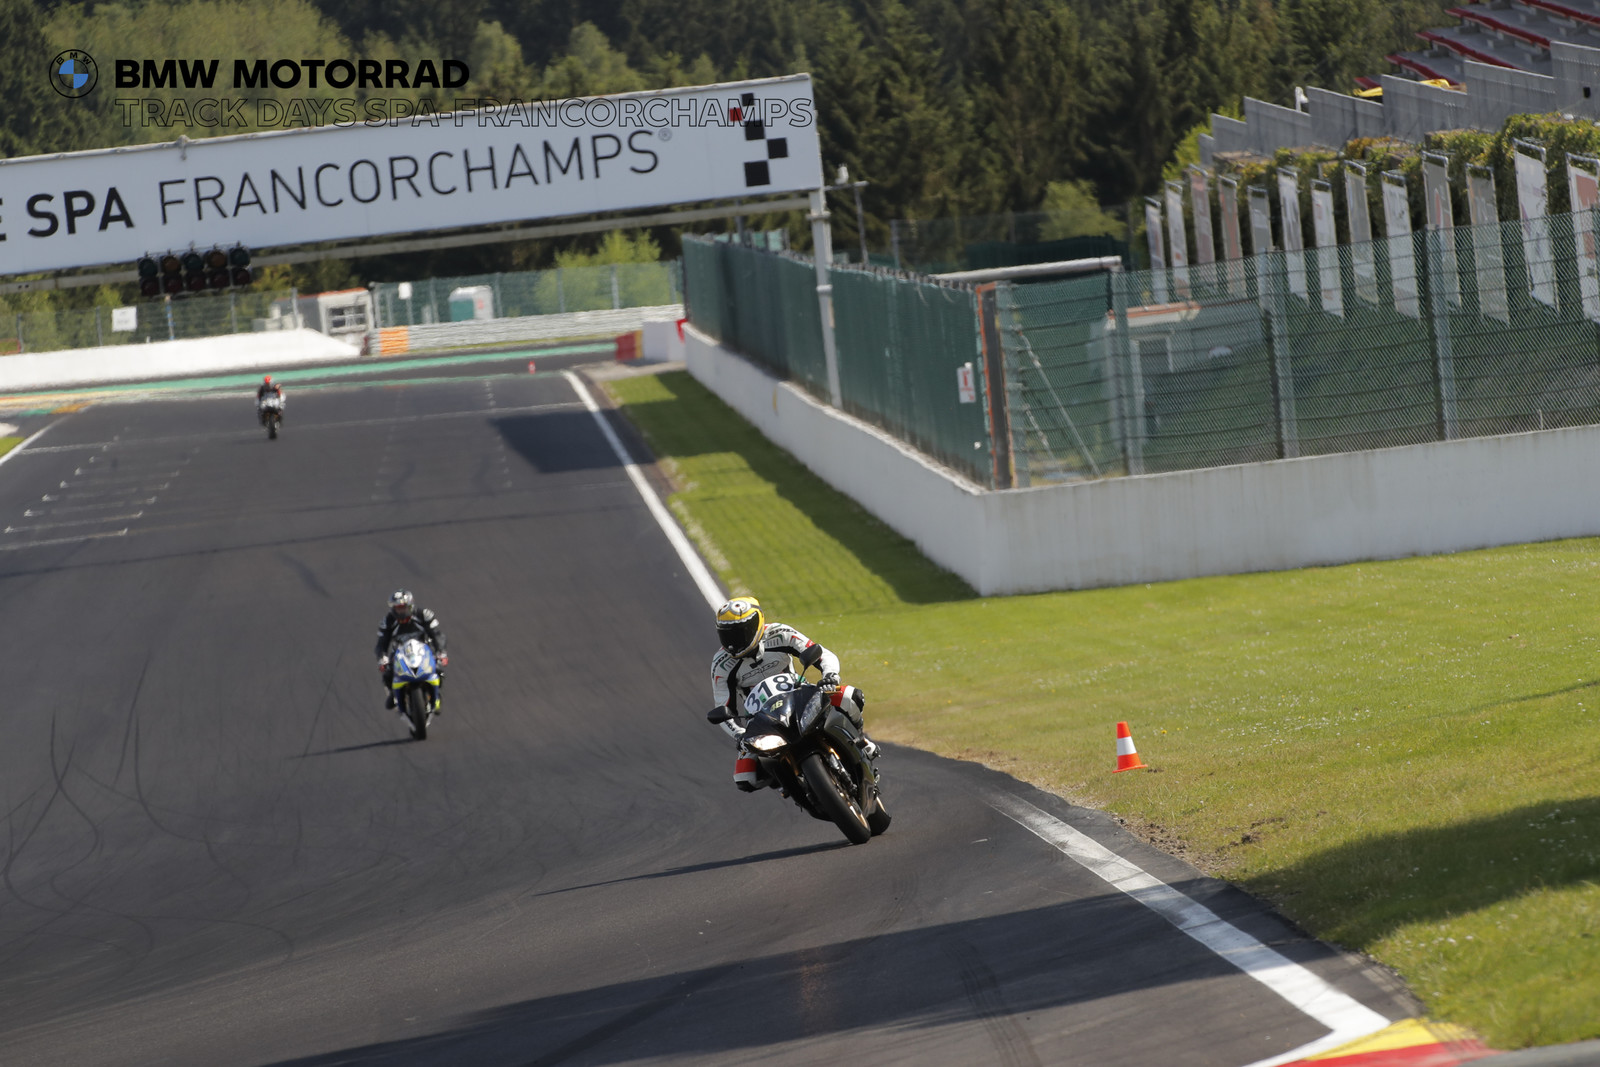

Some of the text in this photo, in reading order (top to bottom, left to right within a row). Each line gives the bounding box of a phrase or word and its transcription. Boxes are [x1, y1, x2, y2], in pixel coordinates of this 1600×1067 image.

[26, 187, 135, 238] SPA
[159, 129, 659, 225] FRANCORCHAMPS
[747, 675, 793, 712] 318
